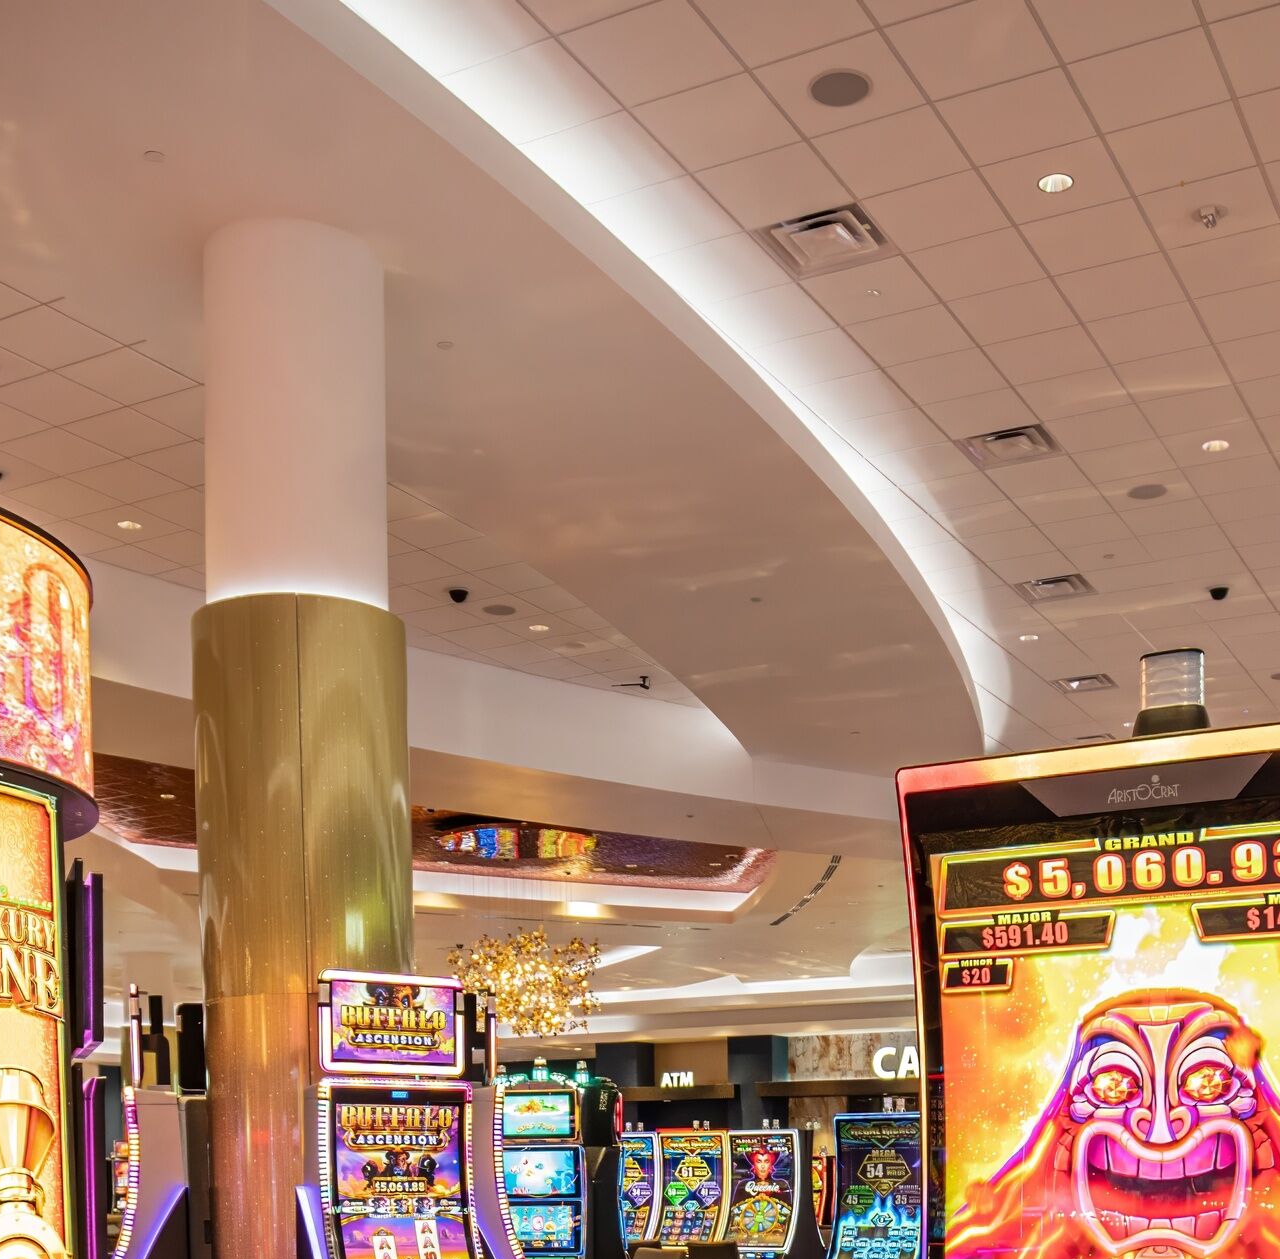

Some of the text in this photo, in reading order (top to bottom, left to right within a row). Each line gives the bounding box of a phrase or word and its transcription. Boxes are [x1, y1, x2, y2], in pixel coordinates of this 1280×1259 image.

[1107, 775, 1181, 804] ARISTOCRAT
[1105, 832, 1195, 850] GRAND
[997, 911, 1052, 925] MAJOR
[981, 921, 1069, 949] $591.40
[960, 958, 993, 967] MINOR
[961, 967, 991, 985] $20
[341, 1005, 447, 1030] BUFFALO
[355, 1034, 433, 1046] ASCENSION
[661, 1071, 695, 1088] ATM
[341, 1105, 453, 1128] BUFFALO
[356, 1134, 438, 1145] ASCENSION
[866, 1164, 883, 1179] 54
[744, 1181, 780, 1196] Queenie
[846, 1194, 858, 1205] 45
[895, 1194, 907, 1205] 35
